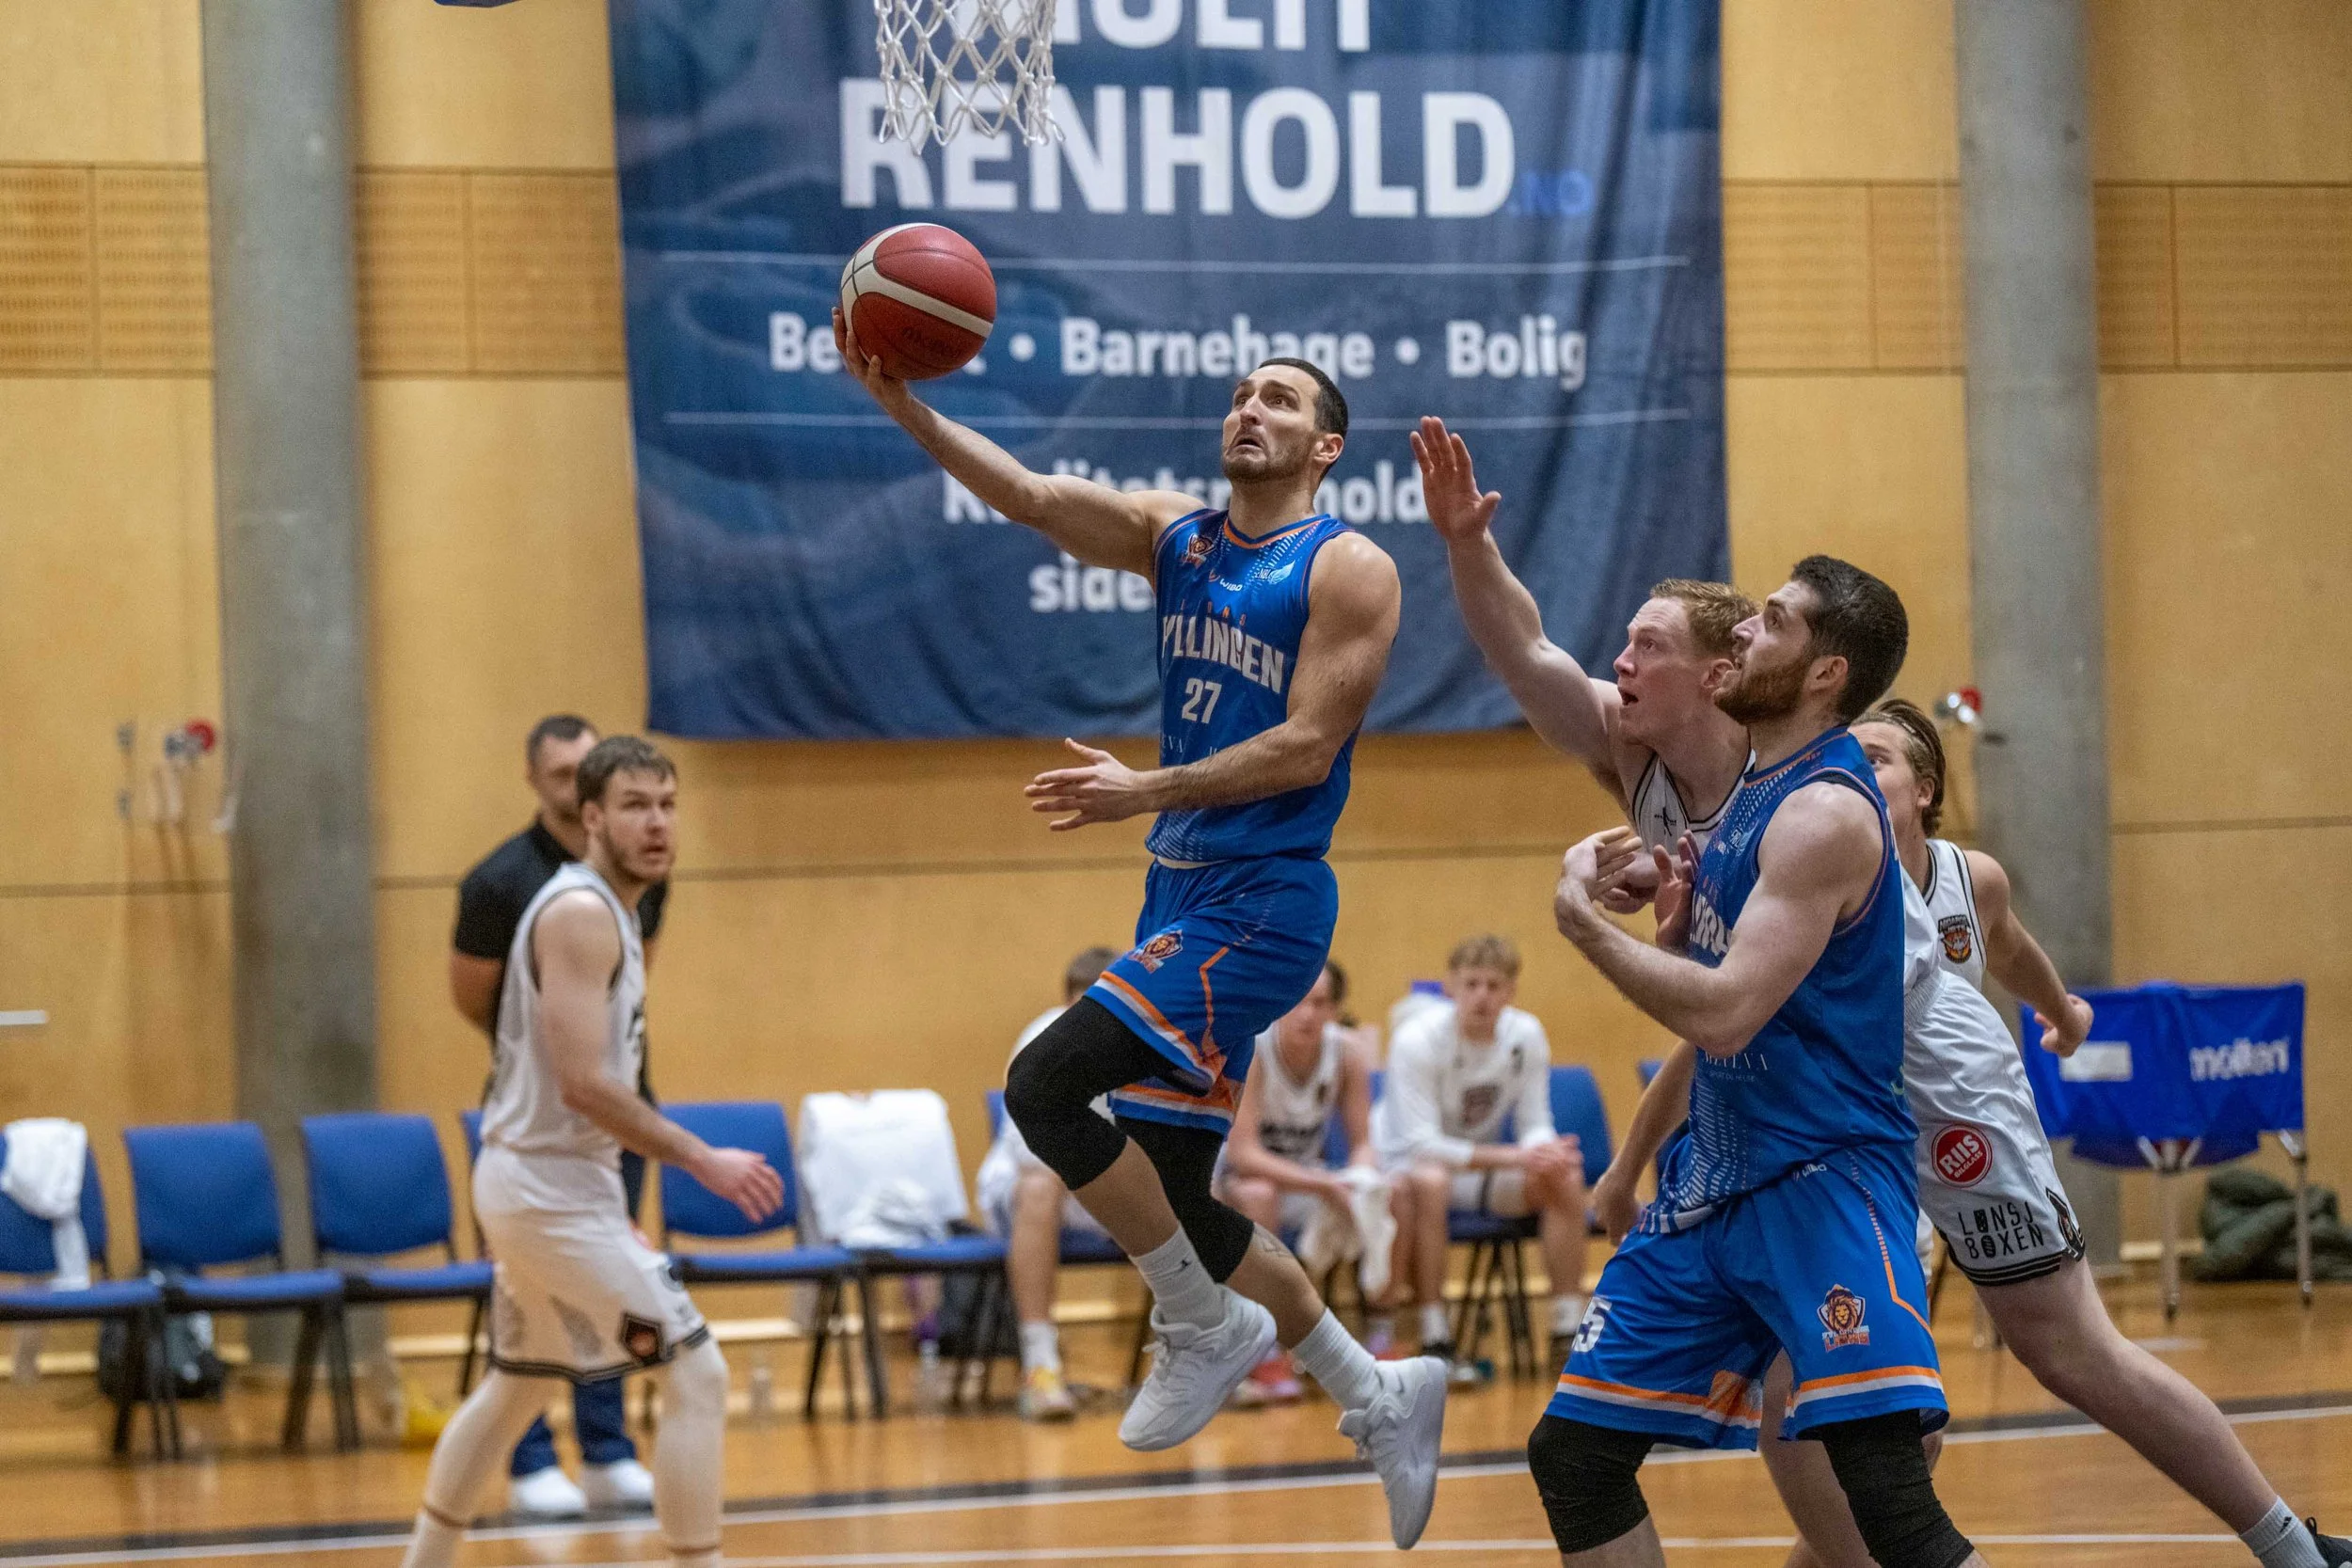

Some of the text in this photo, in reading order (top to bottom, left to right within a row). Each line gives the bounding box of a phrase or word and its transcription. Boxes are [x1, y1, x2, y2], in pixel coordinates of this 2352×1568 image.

[1060, 313, 1375, 384] Barnehage
[1446, 315, 1586, 390] Bolig
[1162, 615, 1284, 694] YLLINGEN
[1182, 677, 1222, 723] 27
[1939, 1134, 1979, 1175] RIIS
